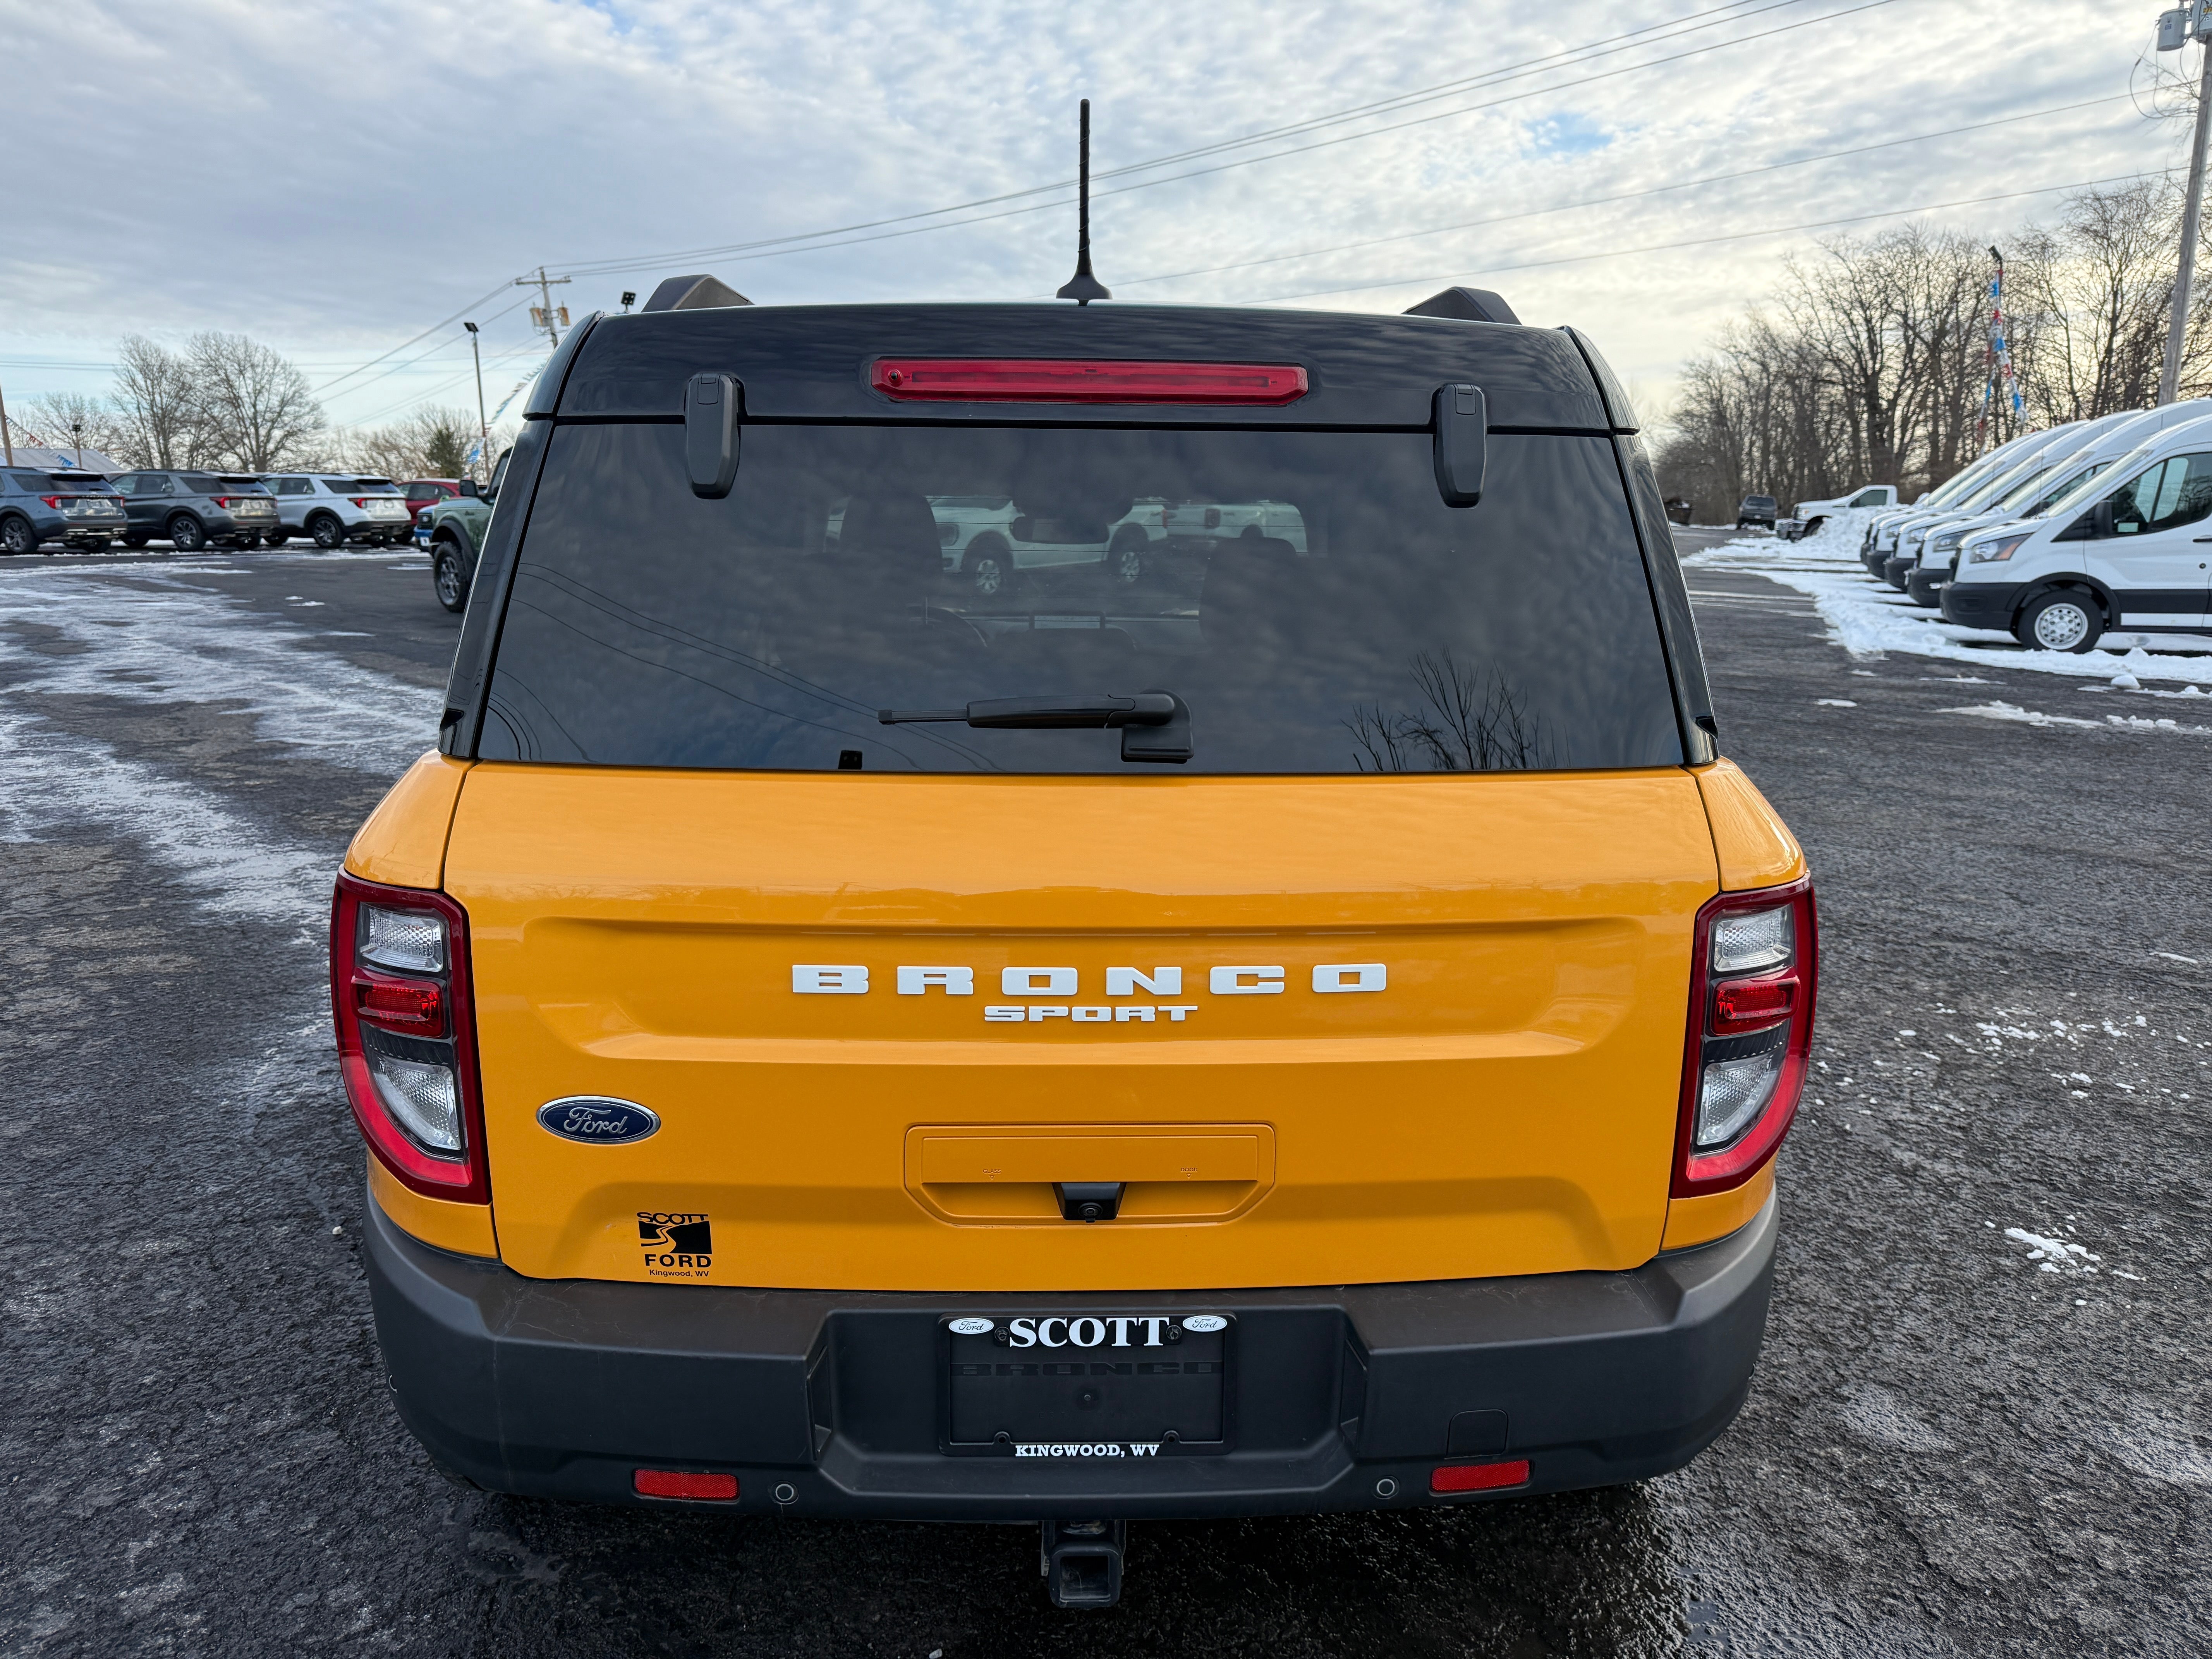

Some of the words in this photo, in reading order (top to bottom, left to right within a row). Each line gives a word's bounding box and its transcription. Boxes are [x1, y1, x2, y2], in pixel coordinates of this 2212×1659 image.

[792, 963, 1387, 995] BRONCO
[984, 1005, 1198, 1022] SPORT
[563, 1107, 628, 1134] Ford
[637, 1212, 709, 1225] SCOTT
[644, 1254, 712, 1268] FORD
[958, 1321, 984, 1331] Ford
[1192, 1318, 1218, 1328] Ford
[1010, 1317, 1170, 1347] SCOTT
[950, 1361, 1224, 1376] BRONCO
[1015, 1444, 1125, 1458] KINGWOOD,
[1130, 1444, 1159, 1456] WV
